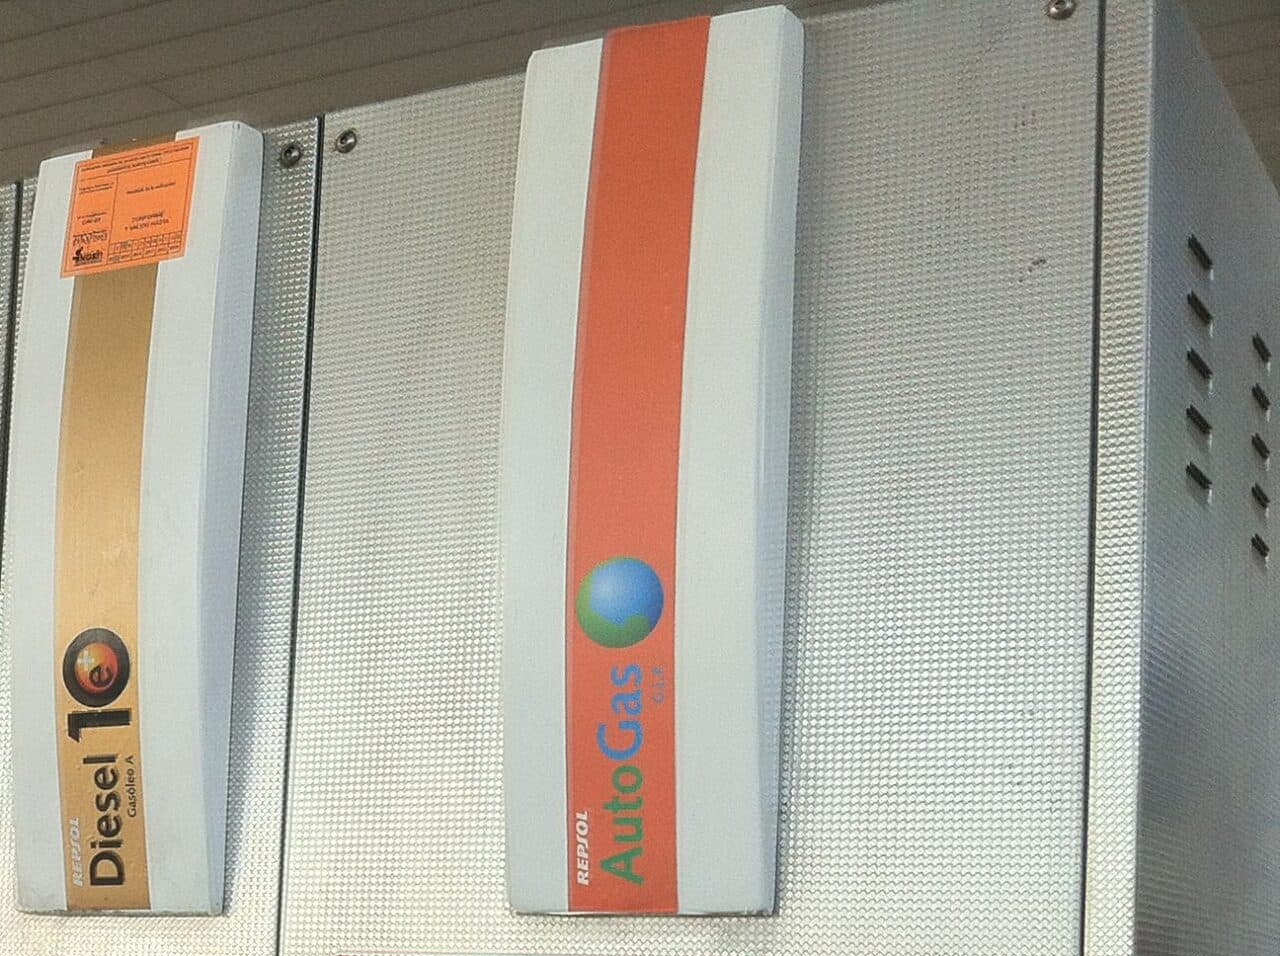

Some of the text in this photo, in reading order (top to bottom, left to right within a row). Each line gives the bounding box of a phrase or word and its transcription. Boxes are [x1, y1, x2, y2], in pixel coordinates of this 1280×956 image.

[82, 754, 126, 886] Diesel
[126, 755, 138, 818] Gasóleo A
[596, 663, 645, 886] AutoGas
[576, 810, 589, 886] REPSOL
